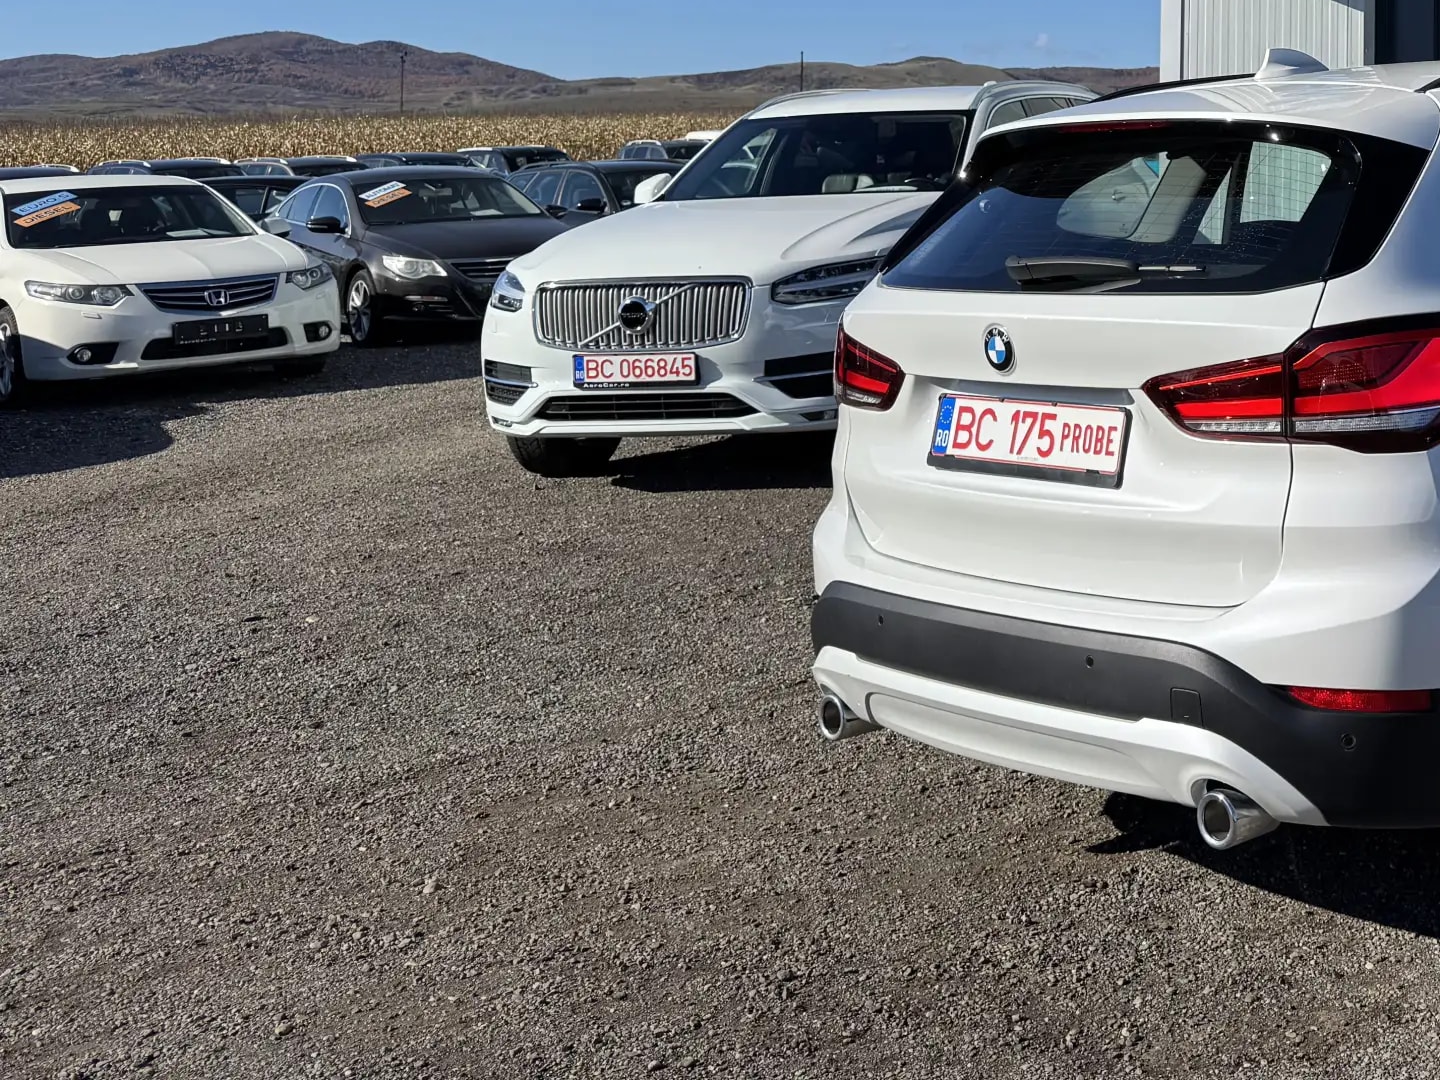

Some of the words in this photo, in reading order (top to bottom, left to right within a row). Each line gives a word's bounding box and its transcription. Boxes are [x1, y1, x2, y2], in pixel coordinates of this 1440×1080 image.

[23, 205, 73, 224] DIESEL
[585, 359, 614, 379] BC
[619, 357, 693, 379] 066845
[934, 429, 949, 447] RO
[952, 405, 998, 452] BC
[1008, 409, 1058, 458] 175
[1059, 422, 1118, 457] PROBE
